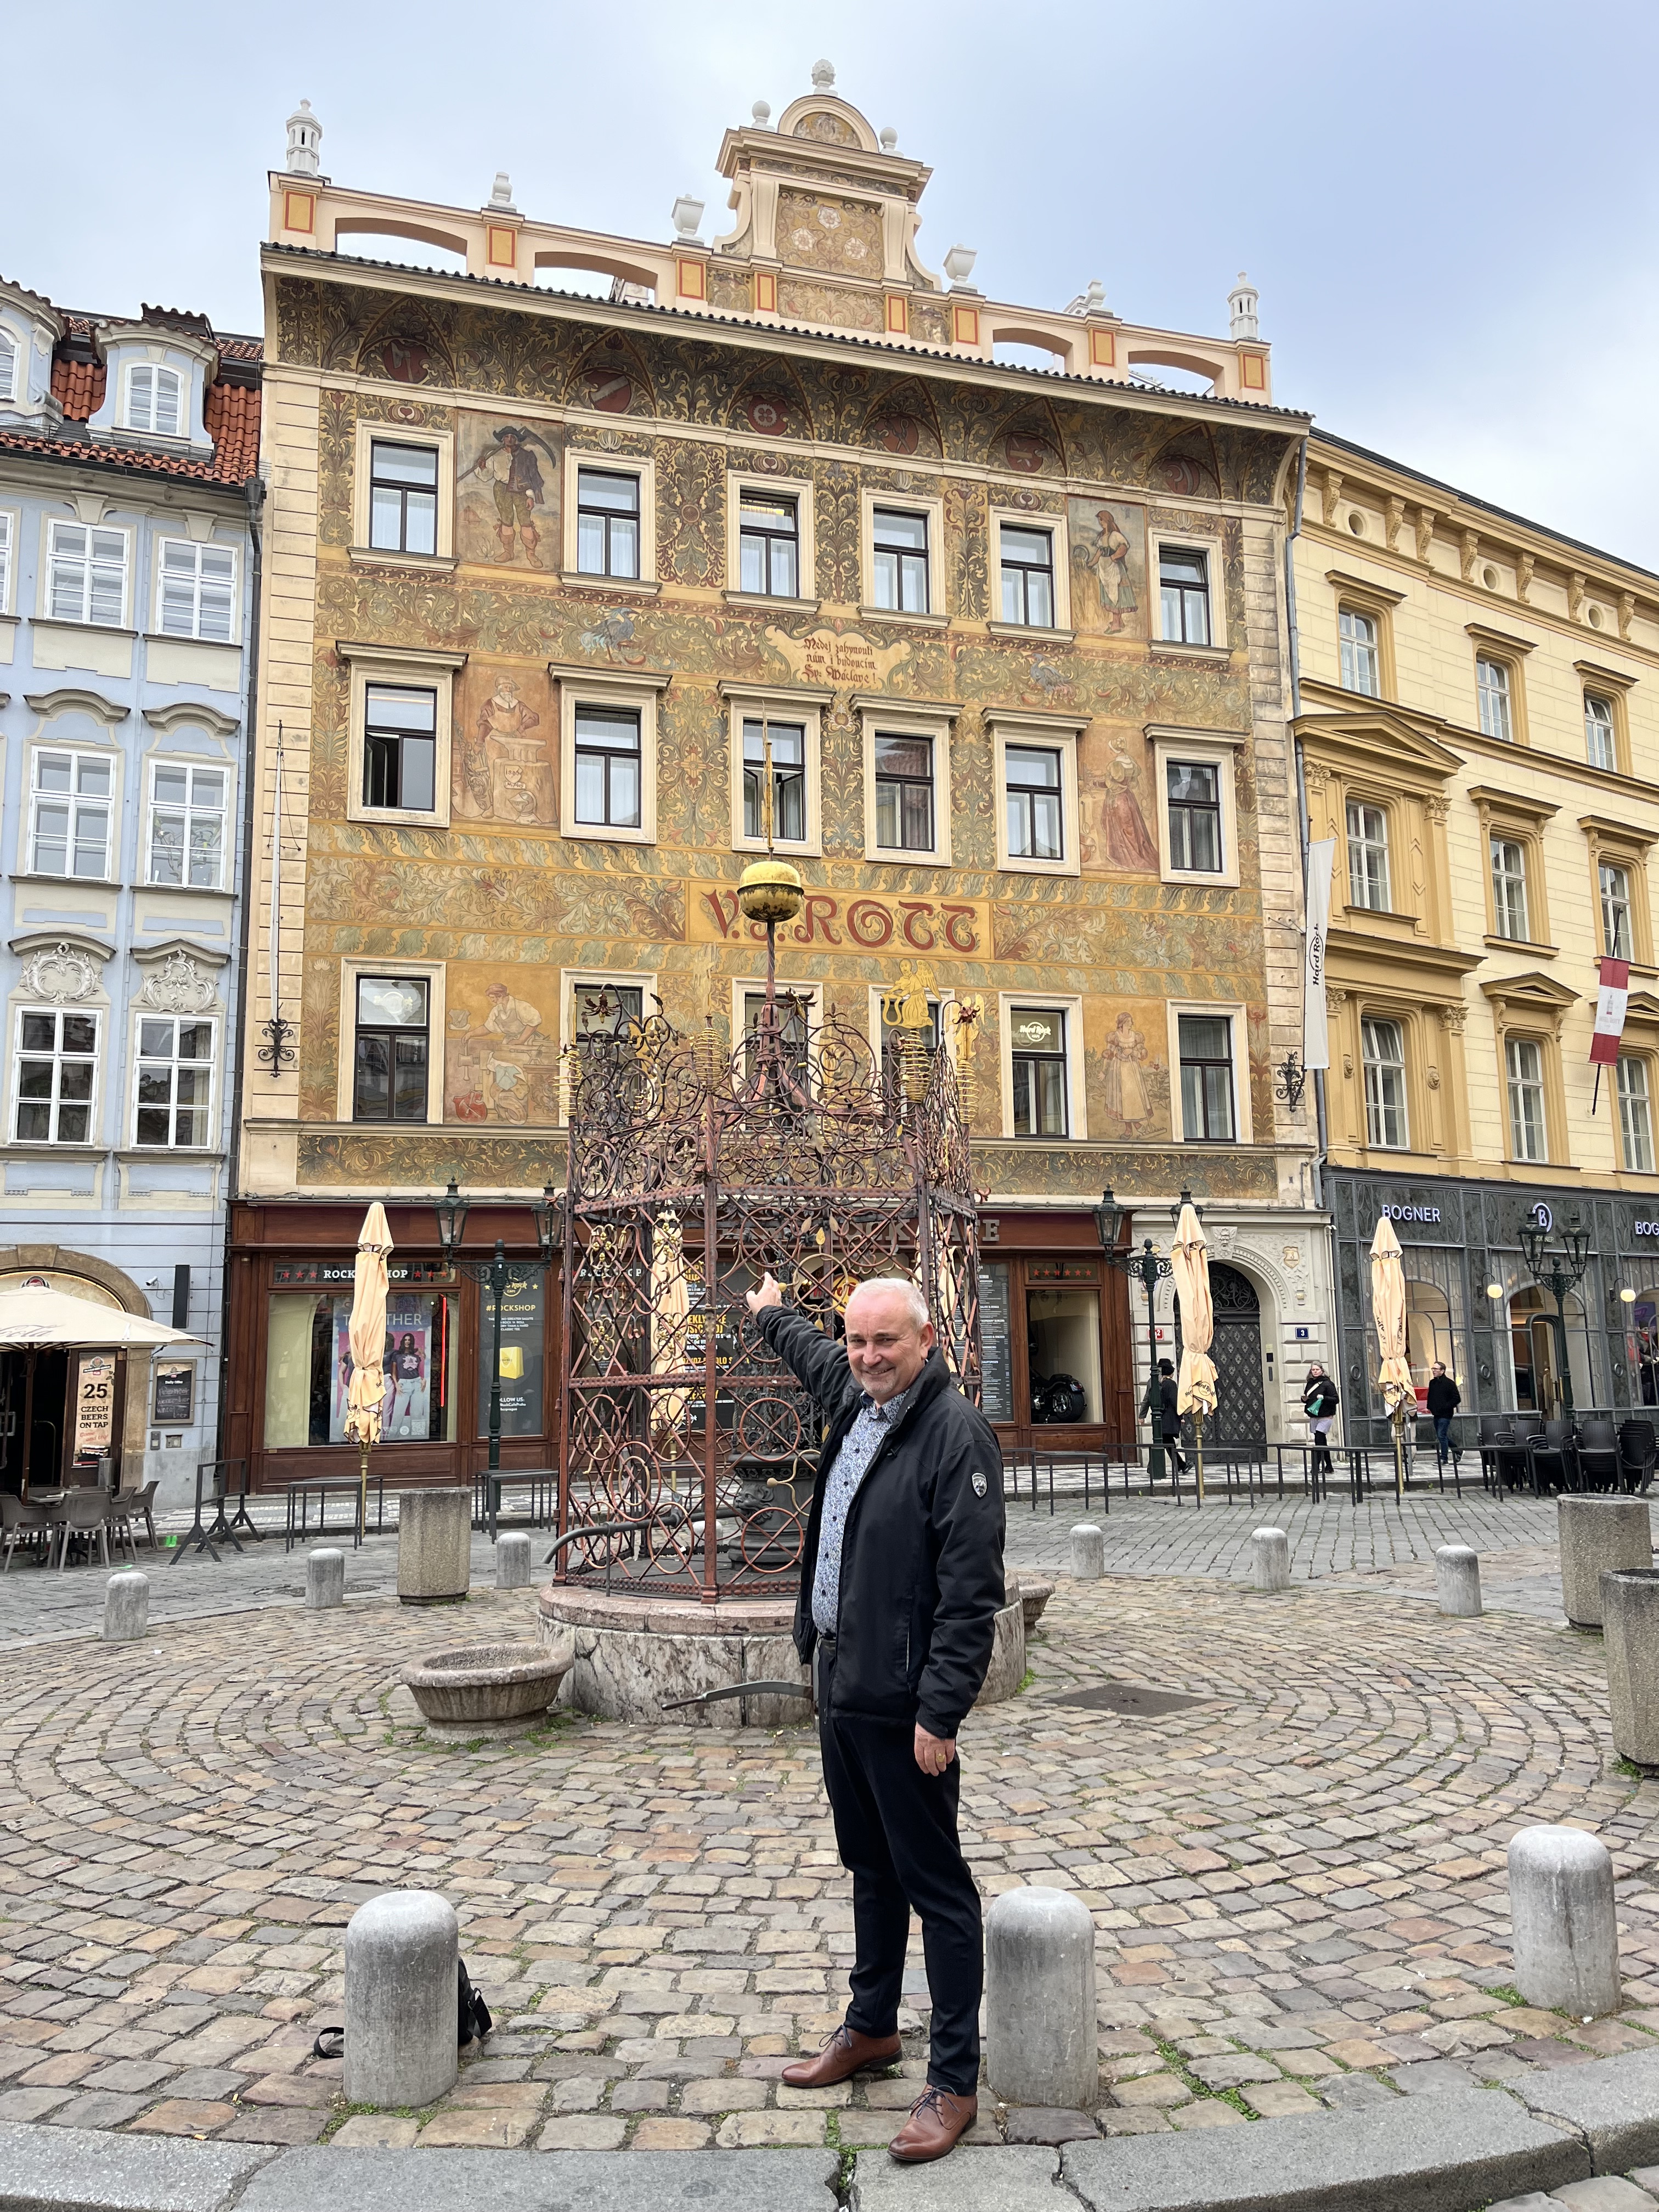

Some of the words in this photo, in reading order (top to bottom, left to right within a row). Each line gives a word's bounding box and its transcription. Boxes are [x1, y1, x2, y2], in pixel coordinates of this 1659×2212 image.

[1381, 1204, 1441, 1222] BOGNER
[323, 1269, 356, 1279] ROCK
[387, 1269, 408, 1278] HOP
[83, 1384, 108, 1398] 25
